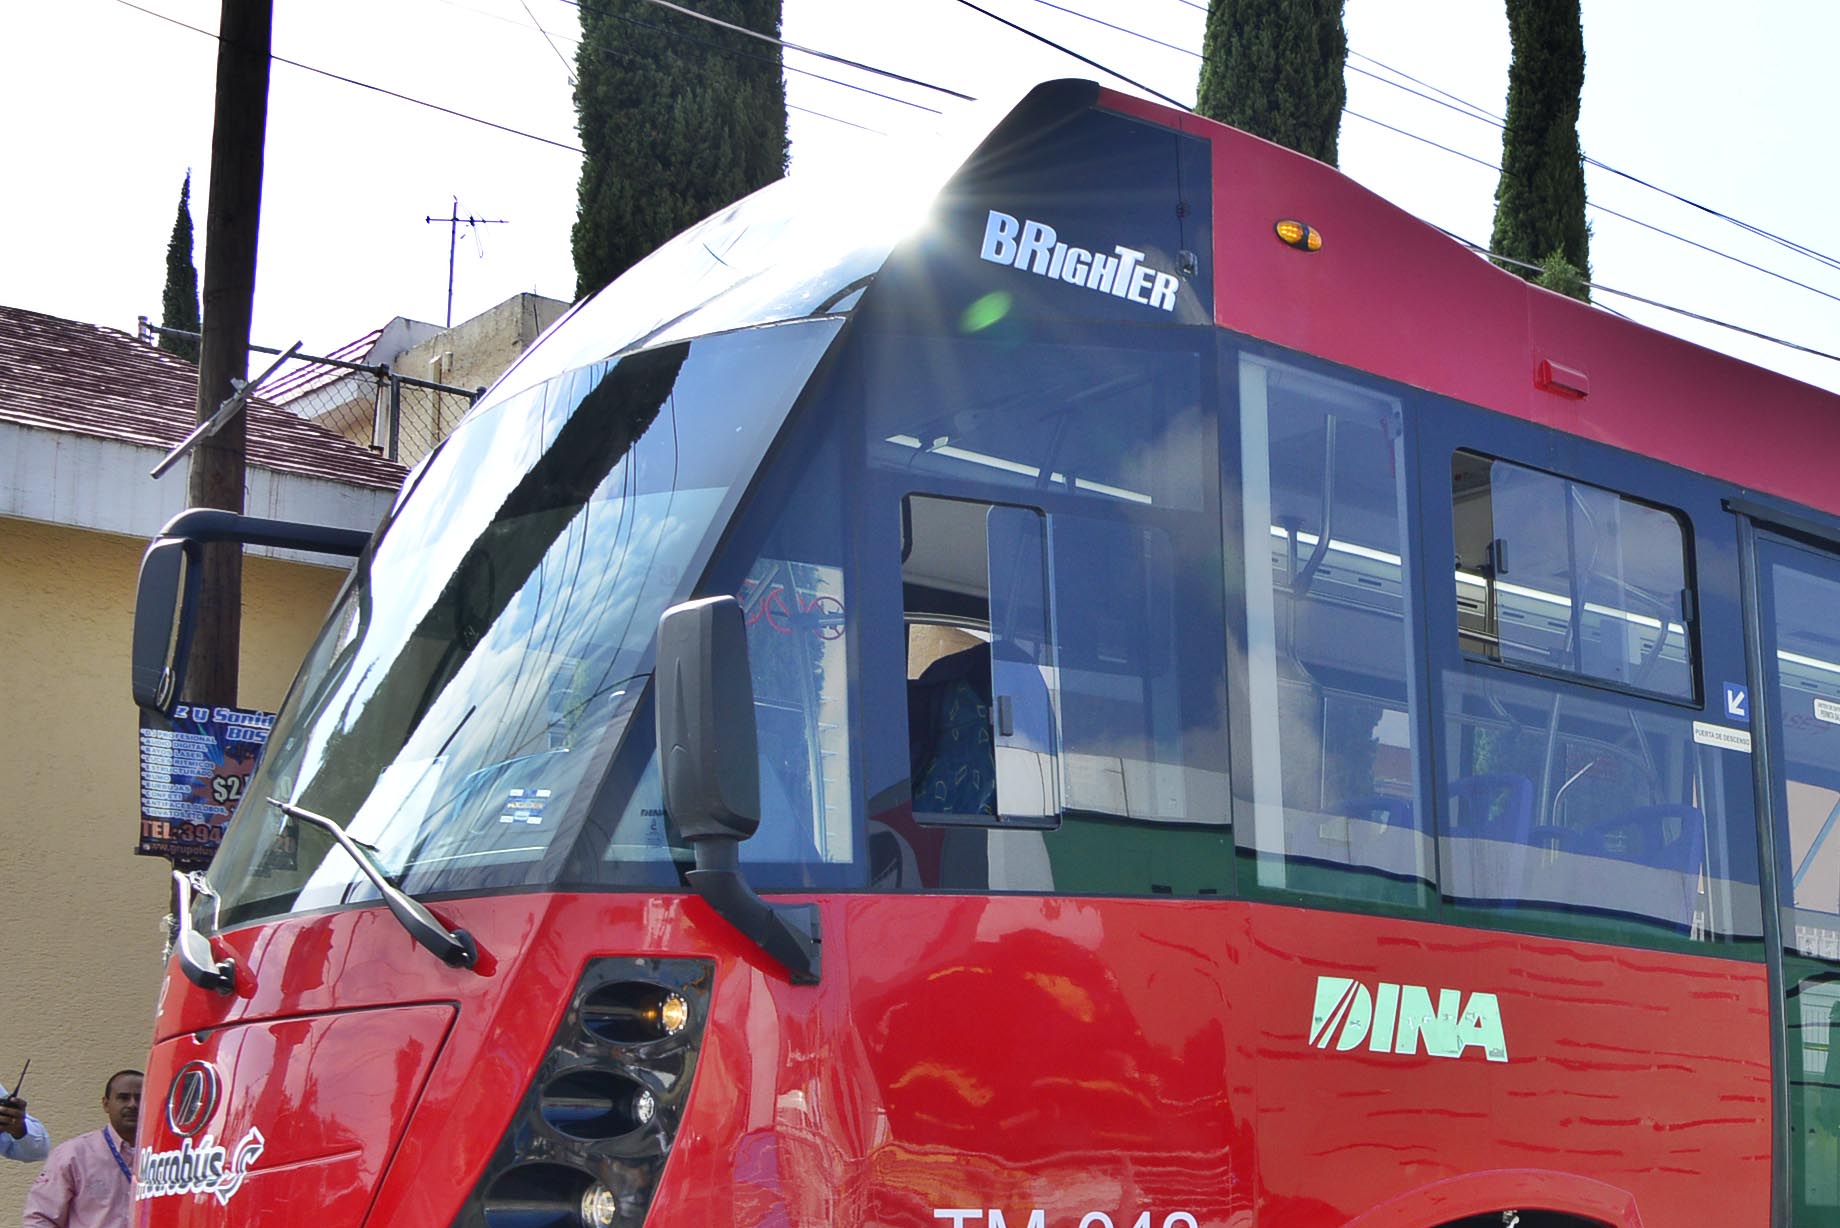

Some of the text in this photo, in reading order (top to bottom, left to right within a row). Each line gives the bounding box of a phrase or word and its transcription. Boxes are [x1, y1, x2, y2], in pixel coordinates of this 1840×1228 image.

[212, 707, 277, 729] Sonid
[157, 730, 217, 744] PROFESIONAL
[226, 725, 271, 744] BOS
[1695, 728, 1715, 739] PUERTA
[1715, 732, 1723, 741] DE
[145, 738, 209, 752] AUDIO DIGITAL
[174, 750, 204, 760] LASER
[145, 782, 192, 793] BURBUJAS
[145, 790, 183, 800] CONFETI
[213, 774, 248, 802] $2
[179, 822, 222, 843] 394
[1308, 976, 1508, 1062] DINA
[137, 1136, 226, 1193] Macrobús
